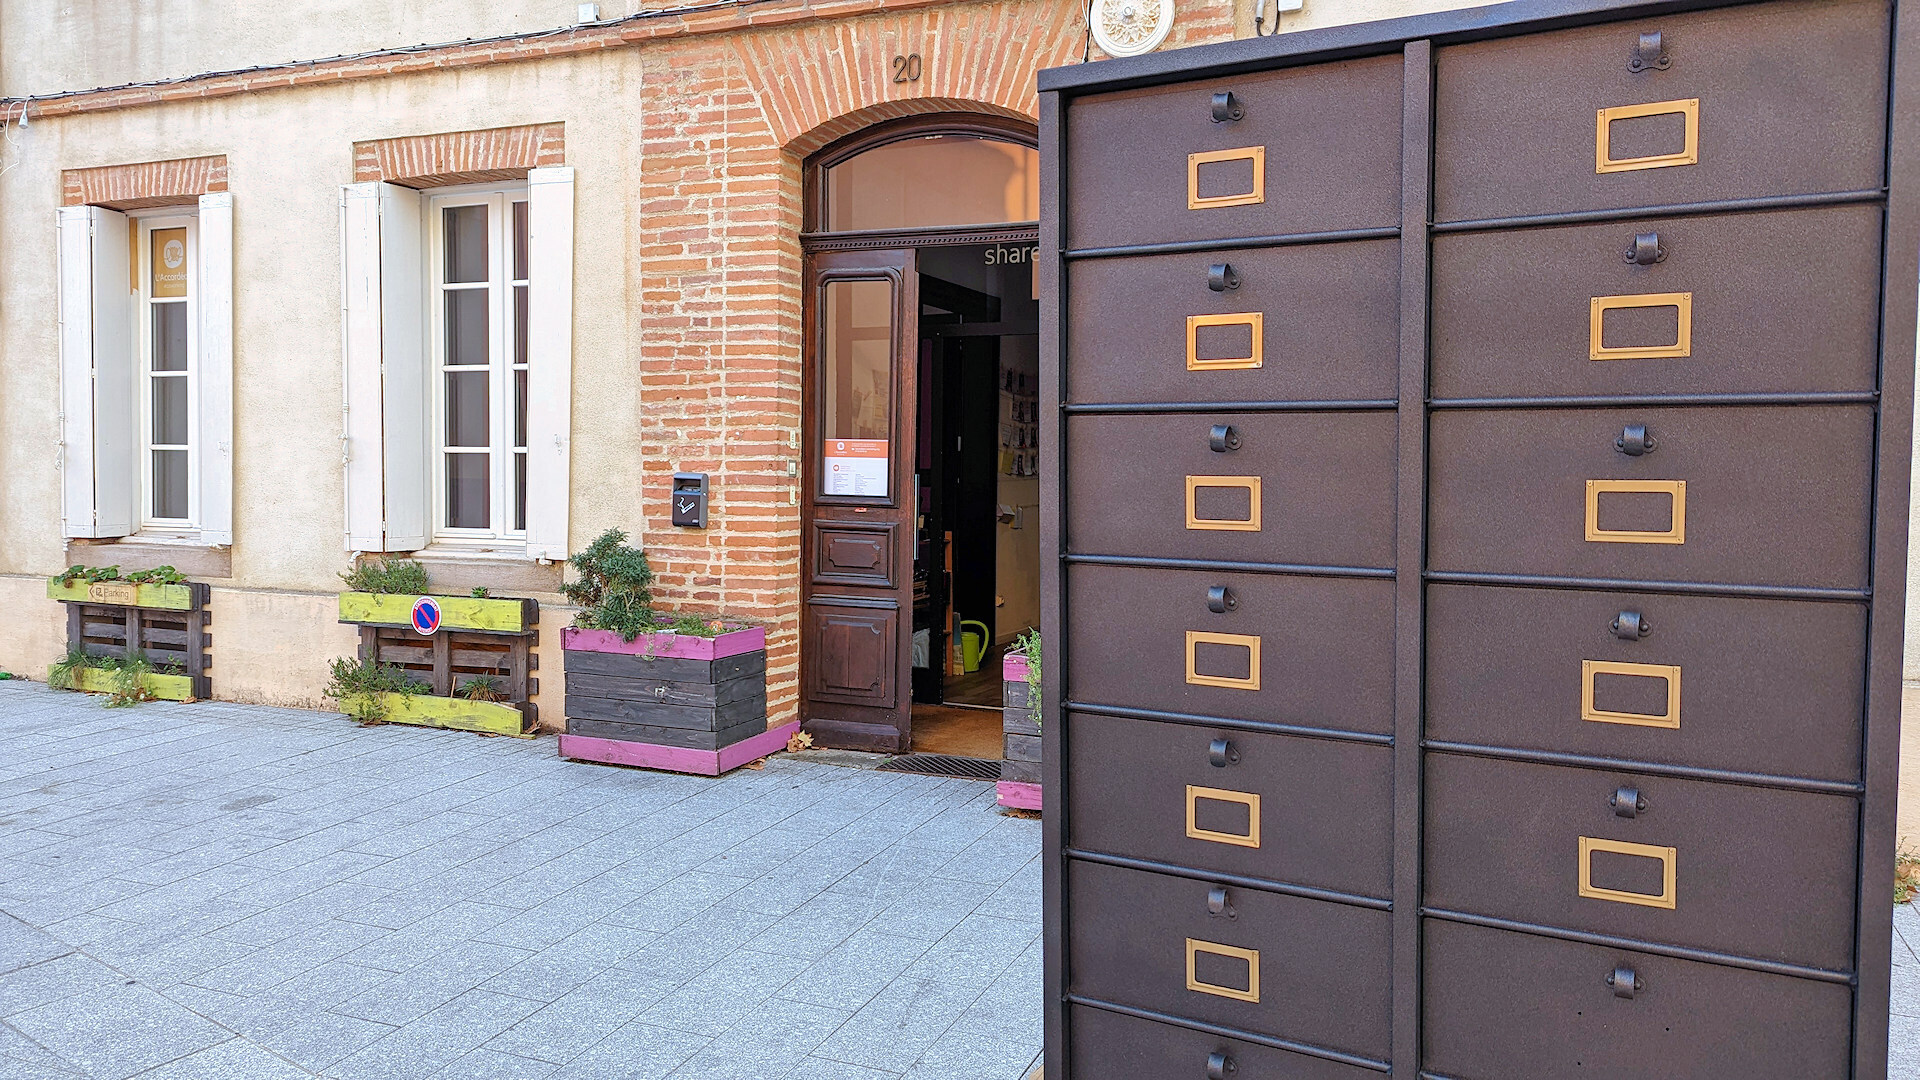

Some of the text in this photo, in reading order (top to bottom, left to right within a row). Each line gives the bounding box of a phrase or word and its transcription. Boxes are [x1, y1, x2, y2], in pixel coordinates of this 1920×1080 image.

[893, 53, 921, 82] 20
[984, 243, 1039, 265] share
[105, 587, 129, 600] Parking
